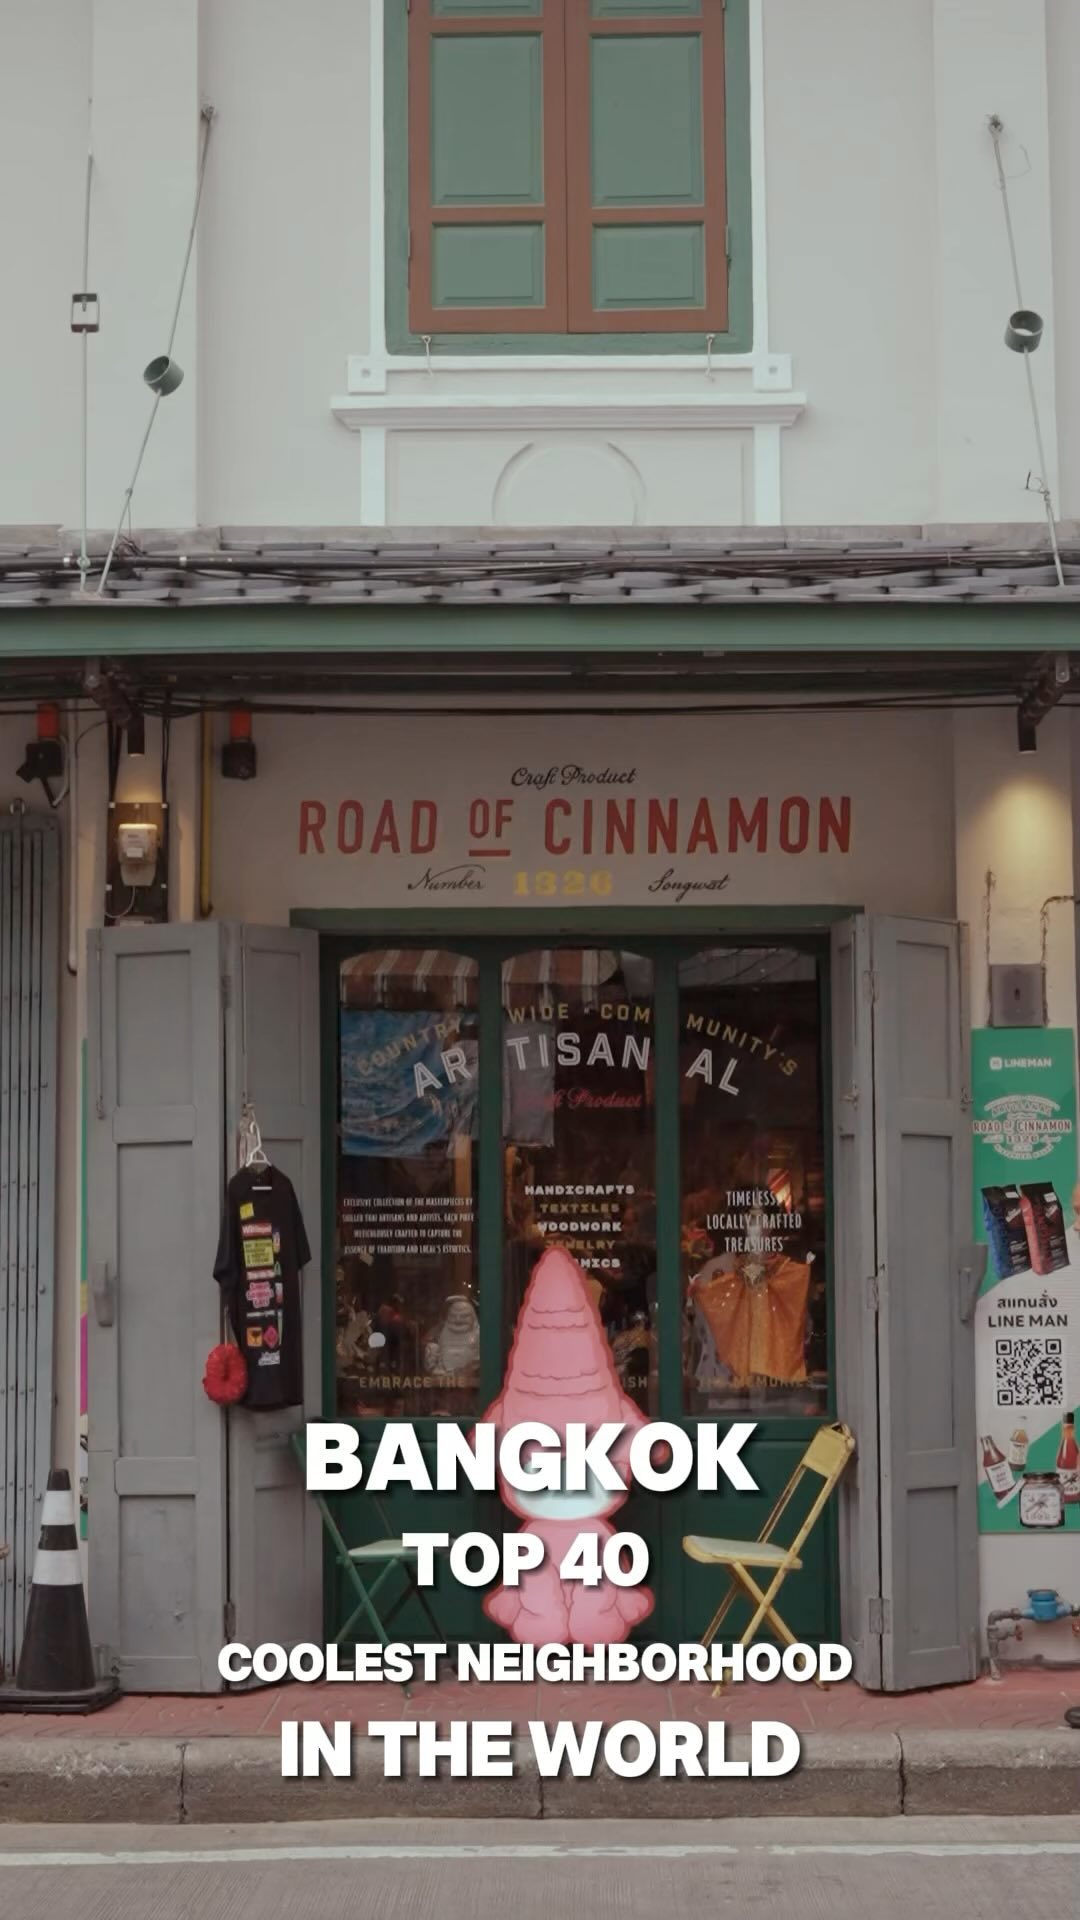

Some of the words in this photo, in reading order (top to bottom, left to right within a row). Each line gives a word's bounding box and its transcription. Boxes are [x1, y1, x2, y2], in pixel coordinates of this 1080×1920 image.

[511, 766, 559, 790] Craft
[561, 764, 636, 785] Product
[299, 800, 438, 855] ROAD
[468, 798, 514, 840] OF
[544, 796, 852, 855] CINNAMON
[408, 864, 486, 890] Number
[648, 868, 730, 902] Songwat
[508, 1003, 569, 1025] WIDE
[567, 1087, 642, 1109] Product
[973, 1121, 1001, 1132] ROAD
[1018, 1120, 1071, 1131] CINNAMON
[524, 1184, 635, 1196] HANDICRAFTS
[540, 1203, 620, 1213] TEXTILES
[537, 1221, 622, 1232] WOODWORK
[706, 1214, 751, 1230] LOCALLY
[997, 1289, 1058, 1308] สแกนสั่ง
[988, 1315, 1025, 1328] LINE
[1029, 1314, 1068, 1327] MAN
[359, 1376, 433, 1389] EMBRACE
